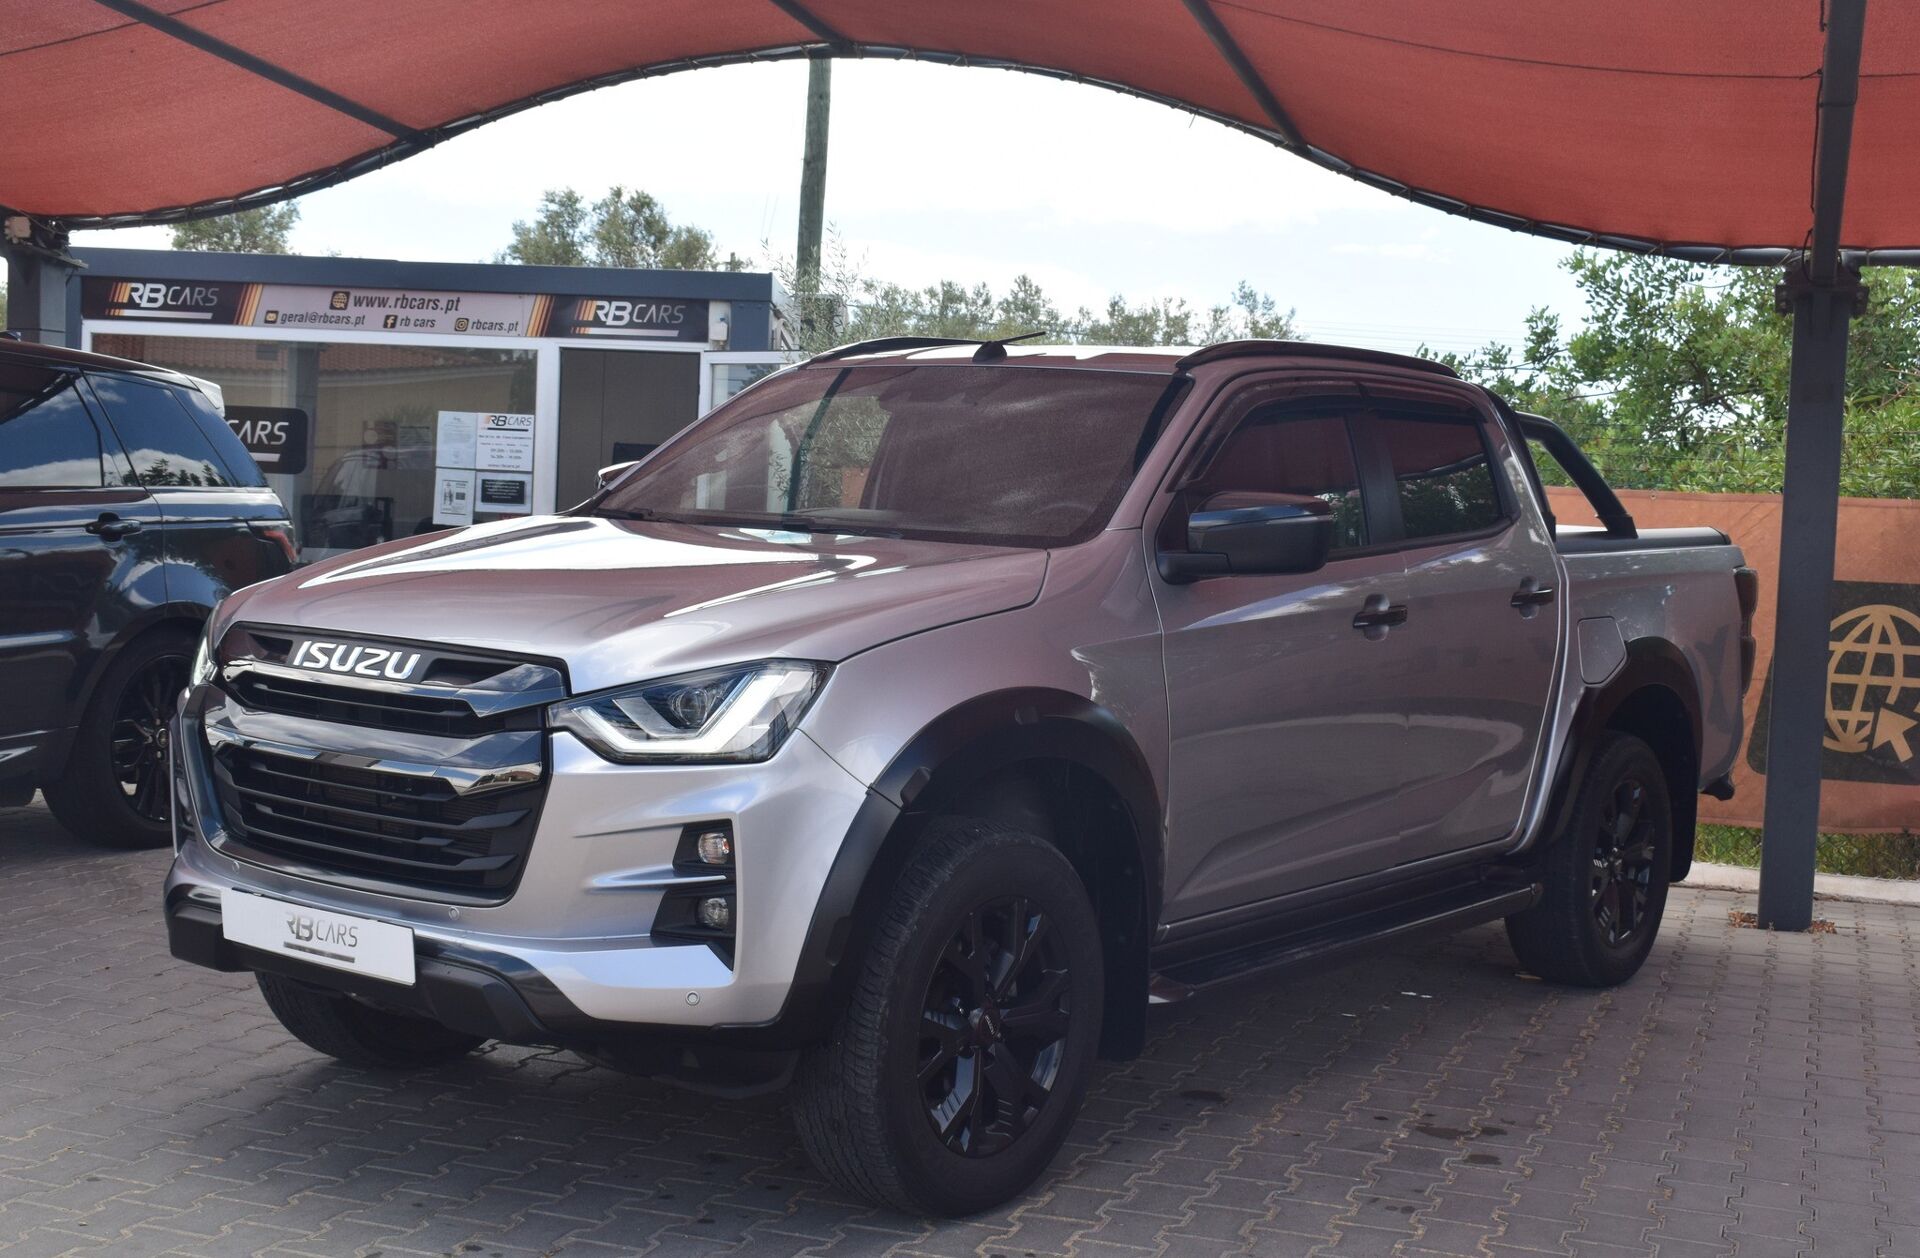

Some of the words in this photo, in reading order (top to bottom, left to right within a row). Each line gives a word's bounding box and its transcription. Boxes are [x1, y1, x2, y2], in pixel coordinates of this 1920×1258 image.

[166, 285, 220, 307] CARS
[353, 293, 461, 314] www.rbcars.pt
[280, 311, 366, 328] geral@rbcars.pt
[400, 315, 411, 328] rb
[413, 318, 437, 329] cars
[632, 303, 687, 325] CARS
[471, 319, 519, 333] rbcars.pt
[507, 416, 533, 427] CARS
[227, 419, 290, 446] ARS
[292, 640, 421, 680] ISUZU
[315, 920, 359, 949] CARS
